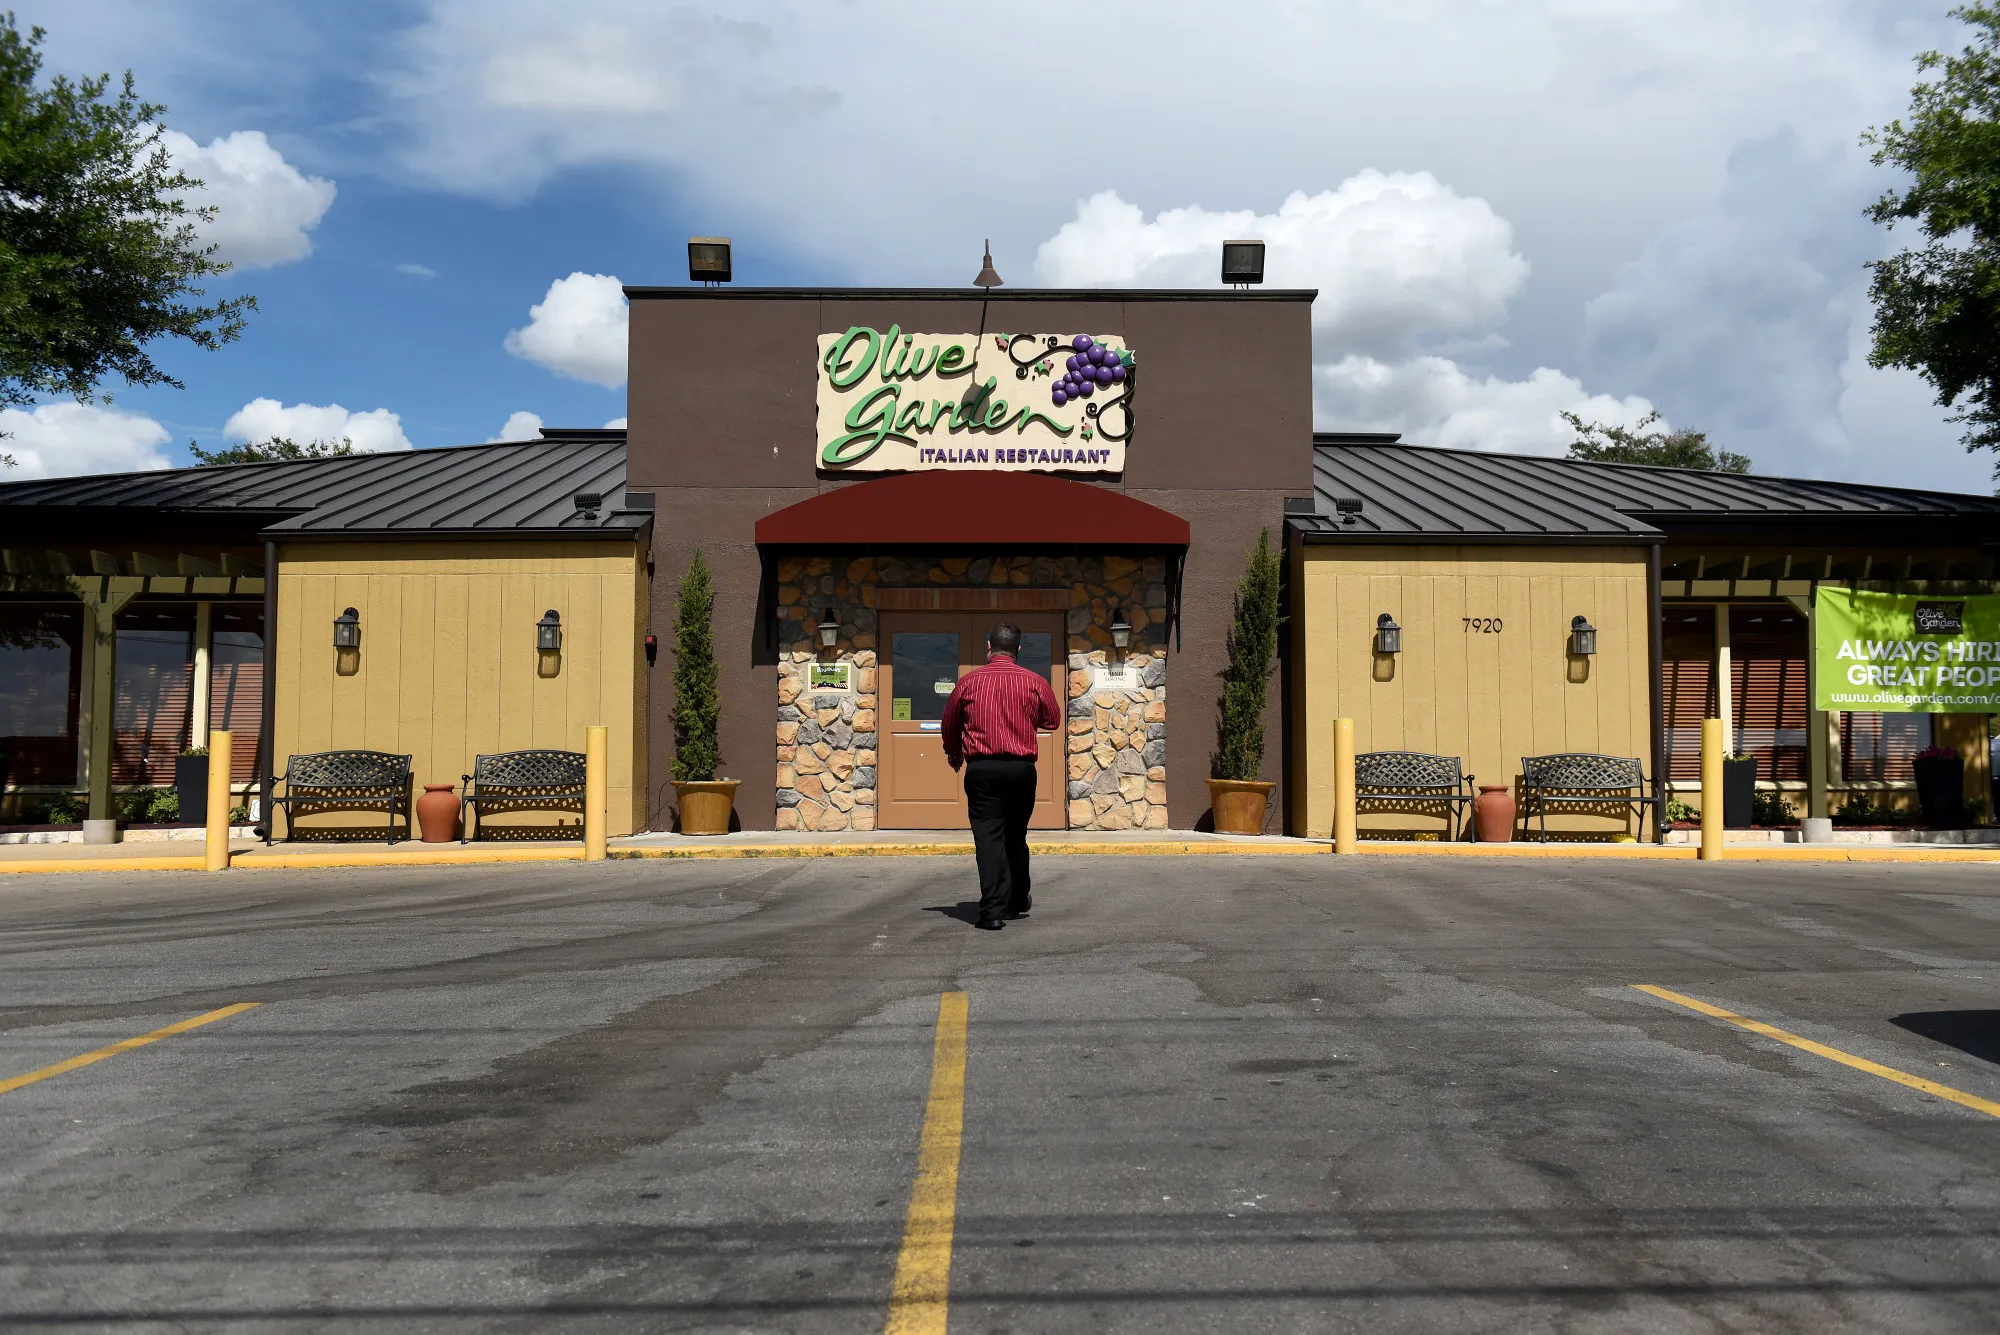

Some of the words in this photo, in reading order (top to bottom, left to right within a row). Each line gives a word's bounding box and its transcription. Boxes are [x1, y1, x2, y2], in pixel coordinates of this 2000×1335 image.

[823, 323, 979, 388] Olive
[821, 375, 1075, 464] Garden
[919, 448, 989, 464] ITALIAN
[995, 448, 1111, 464] RESTAURANT
[1462, 617, 1503, 633] 7920
[1916, 608, 1945, 619] Olive
[1836, 639, 1941, 662] ALWAYS
[1847, 664, 1931, 687] GREAT
